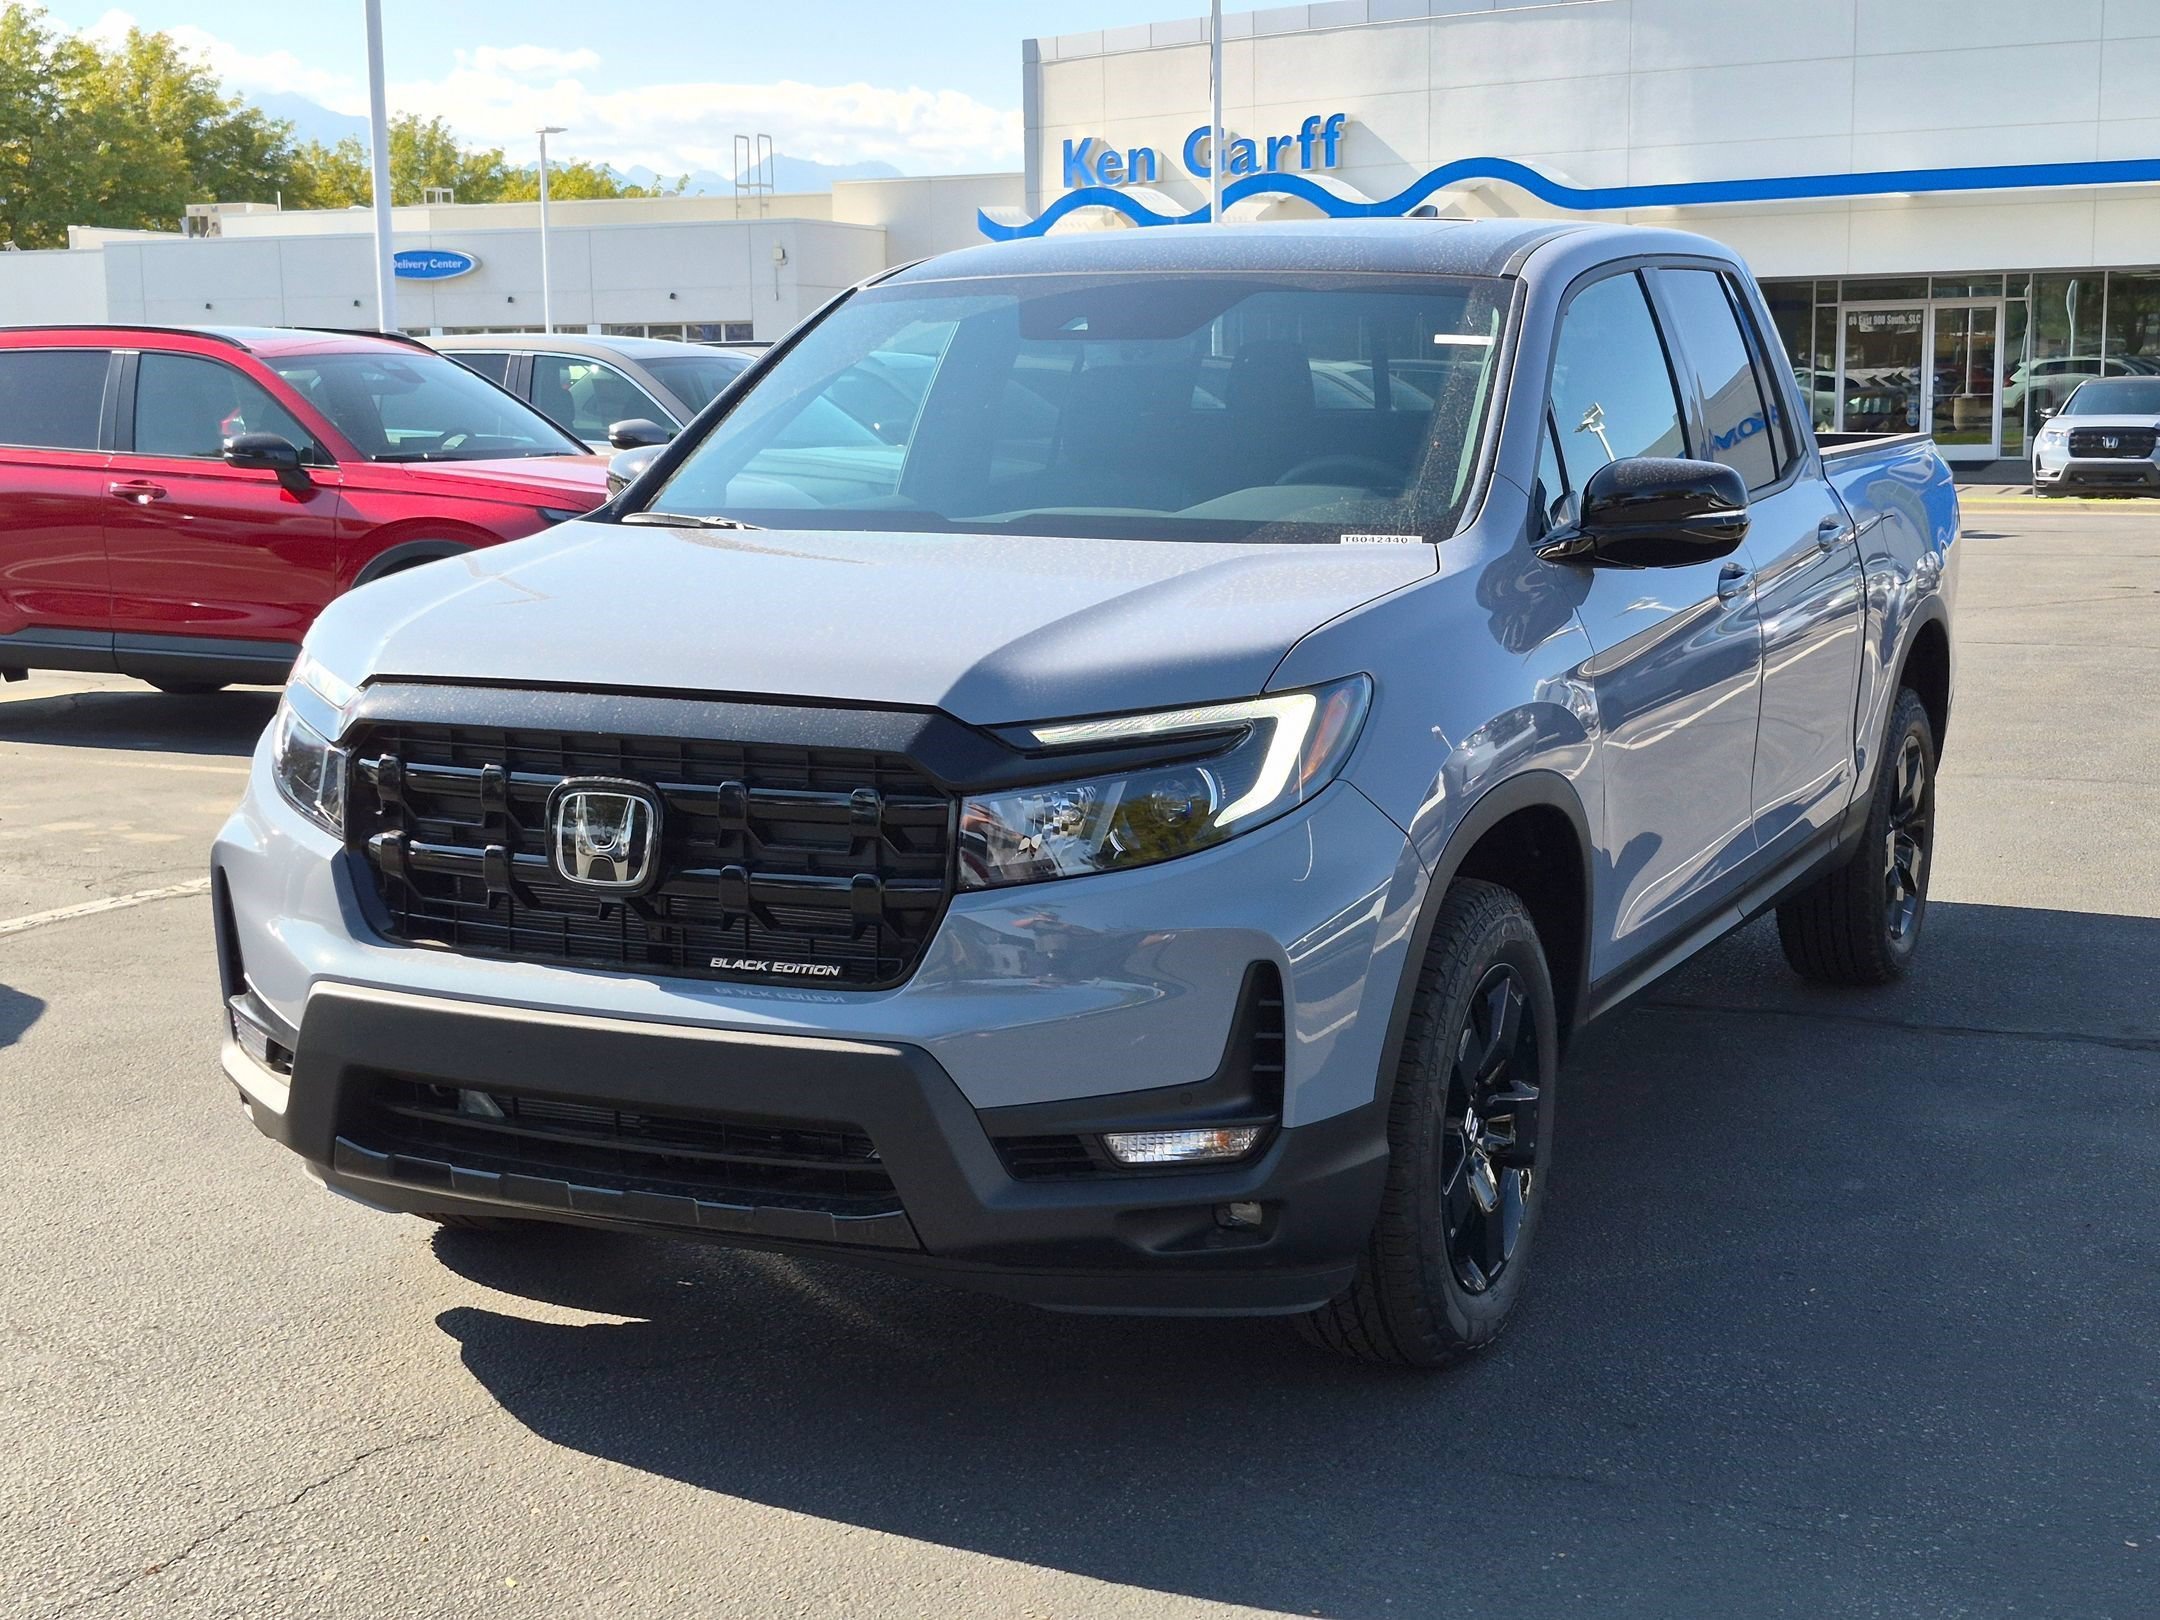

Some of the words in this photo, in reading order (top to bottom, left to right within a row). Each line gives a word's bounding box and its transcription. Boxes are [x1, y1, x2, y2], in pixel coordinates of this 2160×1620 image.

[1062, 137, 1158, 188] Ken
[1183, 112, 1347, 178] Garff
[430, 258, 462, 269] Center
[1909, 314, 1921, 324] SLC
[710, 957, 770, 971] BLACK
[771, 961, 841, 976] EDITION
